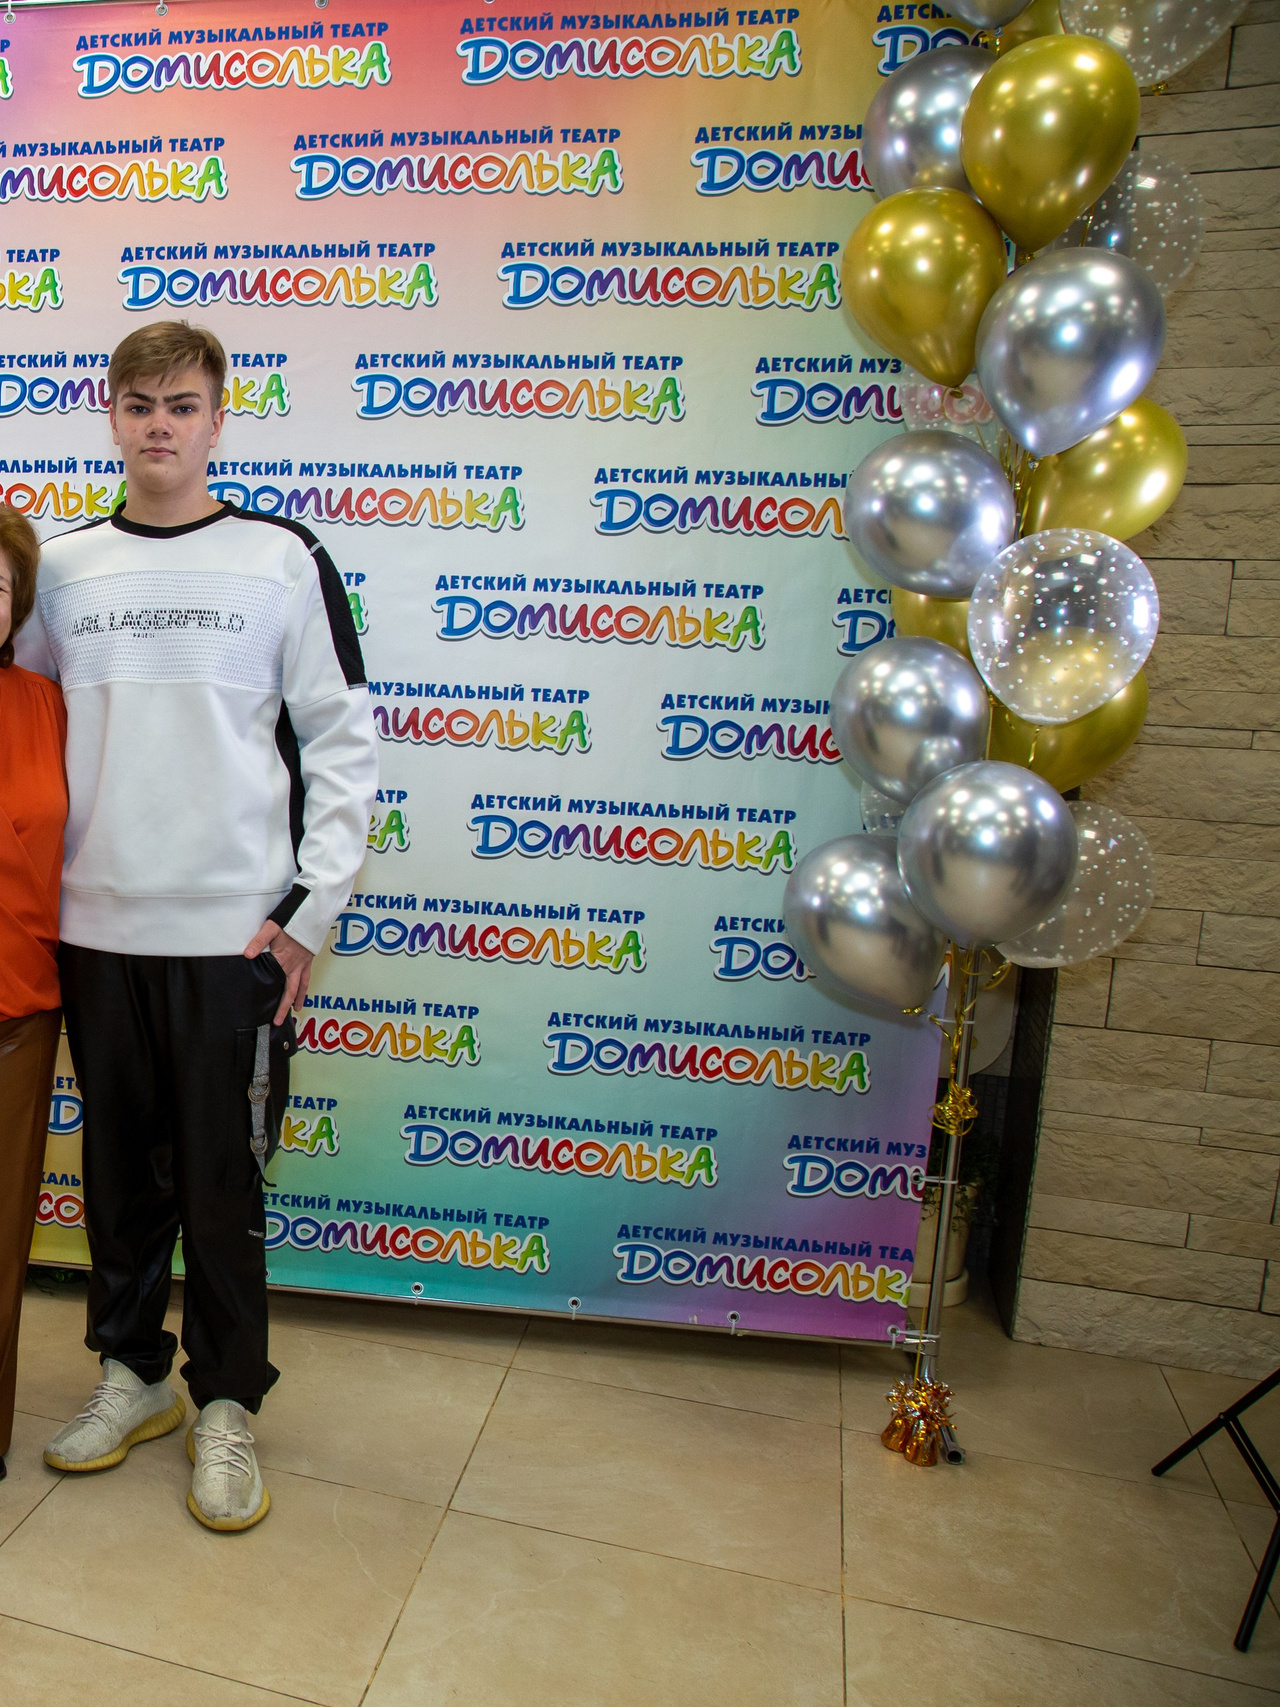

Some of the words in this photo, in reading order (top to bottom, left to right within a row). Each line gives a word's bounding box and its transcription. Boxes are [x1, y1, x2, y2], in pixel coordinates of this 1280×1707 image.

[459, 12, 554, 35] ДЕТСКИЙ
[559, 7, 730, 30] МУЗЫКАЛЬНЫЙ
[734, 8, 800, 26] ТЕАТР
[75, 28, 162, 51] ДЕТСКИЙ
[167, 20, 324, 45] МУЗЫКАЛЬНЫЙ
[329, 21, 389, 38] ТЕАТР
[292, 129, 384, 151] ДЕТСКИЙ
[389, 125, 554, 146] МУЗЫКАЛЬНЫЙ
[558, 127, 622, 143] ТЕАТР
[694, 121, 793, 143] ДЕТСКИЙ
[12, 135, 163, 157] МУЗЫКАЛЬНЫЙ
[167, 136, 226, 152] ТЕАТР
[5, 247, 61, 262] ТЕАТР
[120, 242, 208, 262] ДЕТСКИЙ
[213, 239, 371, 259] МУЗЫКАЛЬНЫЙ
[375, 242, 436, 257] ТЕАТР
[500, 238, 595, 258] ДЕТСКИЙ
[600, 237, 770, 256] МУЗЫКАЛЬНЫЙ
[775, 241, 840, 256] ТЕАТР
[229, 352, 288, 367] ТЕАТР
[354, 350, 446, 369] ДЕТСКИЙ
[451, 351, 616, 369] МУЗЫКАЛЬНЫЙ
[621, 354, 684, 370] ТЕАТР
[754, 354, 853, 373] ДЕТСКИЙ
[82, 459, 125, 474] ТЕАТ
[206, 458, 293, 477] ДЕТСКИЙ
[298, 461, 458, 479] МУЗЫКАЛЬНЫЙ
[462, 464, 523, 480] ТЕАТР
[593, 465, 689, 484] ДЕТСКИЙ
[694, 469, 854, 488] МУЗЫКАЛЬНЫ
[434, 573, 527, 591] ДЕТСКИЙ
[532, 577, 697, 597] МУЗЫКАЛЬНЫЙ
[701, 582, 765, 599] ТЕАТР
[365, 680, 525, 701] МУЗЫКАЛЬНЫЙ
[529, 686, 591, 703] ТЕАТР
[660, 692, 756, 711] ДЕТСКИЙ
[470, 793, 562, 812] ДЕТСКИЙ
[567, 798, 730, 820] МУЗЫКАЛЬНЫЙ
[734, 806, 797, 824] ТЕАТР
[344, 892, 418, 910] ЕТСКИЙ
[422, 897, 581, 920] МУЗЫКАЛЬНЫЙ
[585, 907, 646, 924] ТЕАТР
[301, 993, 418, 1015] ЫКАЛЬНЫЙ
[421, 1001, 481, 1019] ТЕАТР
[546, 1011, 639, 1031] ДЕТСКИЙ
[643, 1017, 806, 1042] МУЗЫКАЛЬНЫЙ
[809, 1029, 872, 1047] ТЕАТР
[403, 1103, 492, 1124] ДЕТСКИЙ
[496, 1111, 654, 1136] МУЗЫКАЛЬНЫЙ
[658, 1123, 719, 1141] ТЕАТР
[786, 1133, 881, 1154] ДЕТСКИЙ
[260, 1191, 331, 1210] ЕТСКИЙ
[335, 1197, 489, 1224] МУЗЫКАЛЬНЫЙ
[492, 1211, 551, 1230] ТЕАТР
[615, 1222, 707, 1243] ДЕТСКИЙ
[711, 1230, 874, 1257] МУЗЫКАЛЬНЫЙ
[877, 1244, 916, 1261] ТЕА
[610, 1240, 916, 1307] ДОМИСОЛЬК
